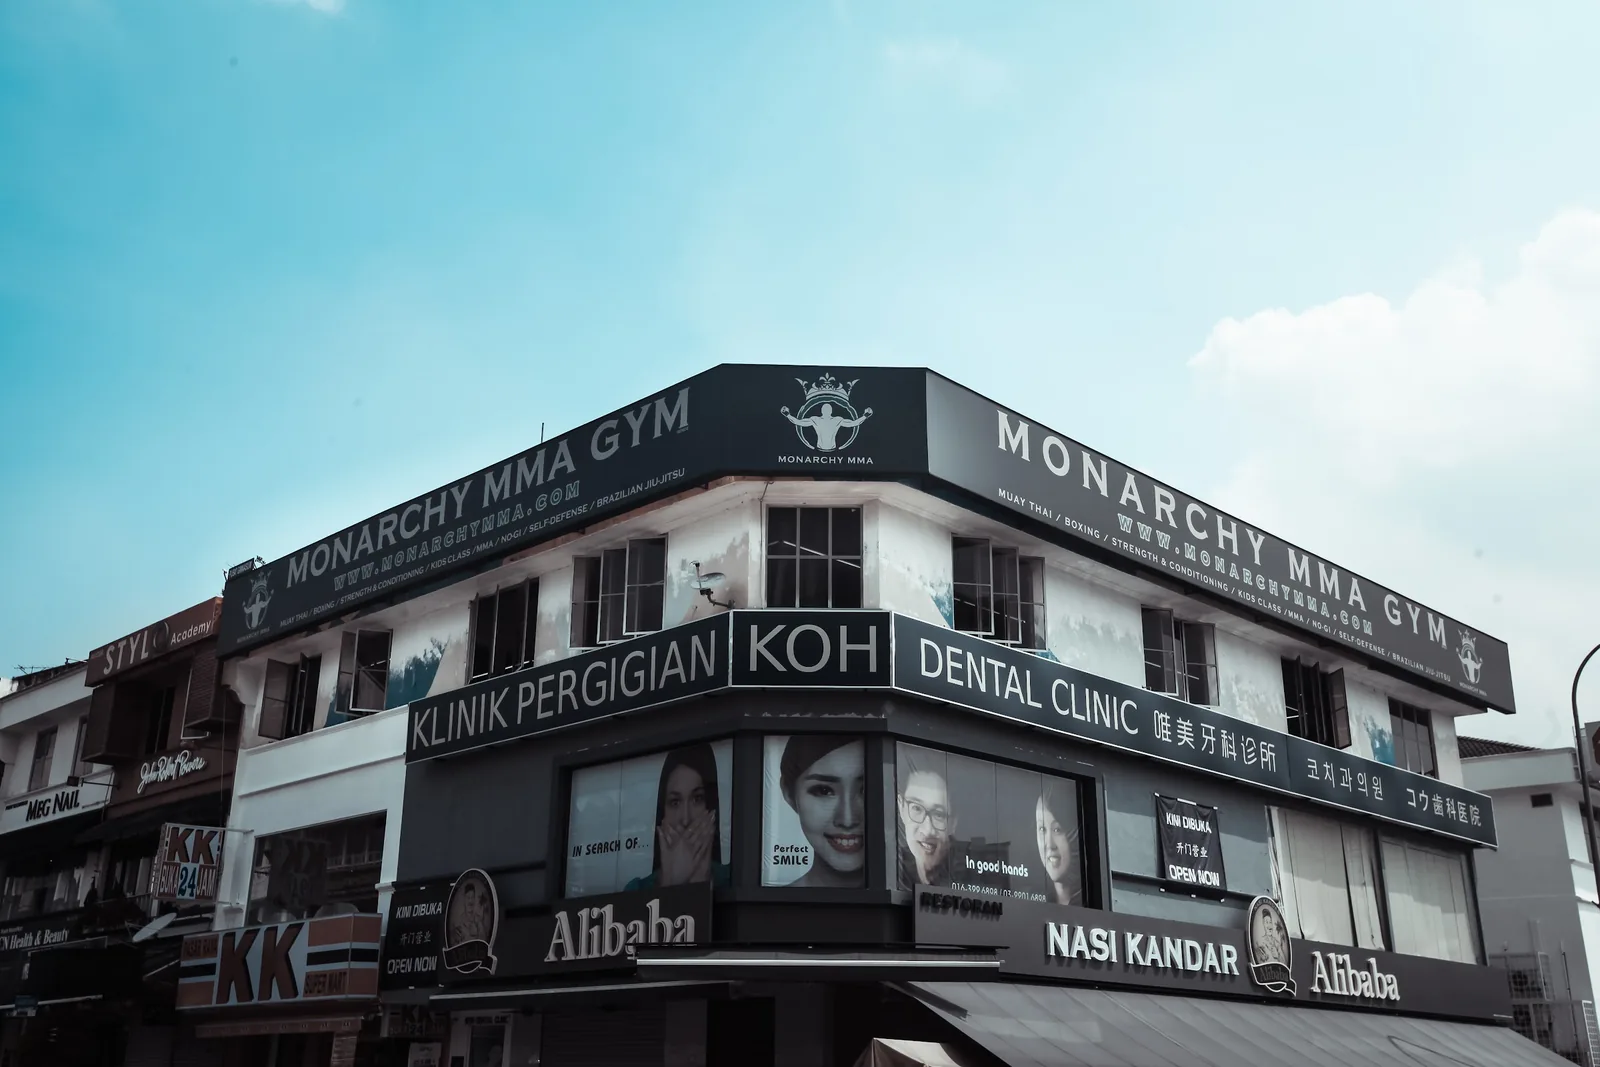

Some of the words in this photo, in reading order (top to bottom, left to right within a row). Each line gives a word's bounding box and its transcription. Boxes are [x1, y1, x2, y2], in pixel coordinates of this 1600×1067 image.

[778, 455, 843, 464] MONARCHY
[847, 456, 874, 465] MMA
[286, 480, 473, 589] MONARCHY
[483, 439, 577, 508] MMA
[590, 387, 690, 460] GYM
[280, 616, 296, 627] MUAY
[313, 600, 335, 615] BOXING
[340, 586, 372, 605] STRENGTH
[377, 566, 424, 591] CONDITIONING
[430, 557, 447, 570] KIDS
[447, 548, 471, 563] CLASS
[529, 504, 588, 532] SELF-DEFENSE
[596, 483, 643, 508] BRAZILIAN
[644, 467, 685, 490] JIU-JITSU
[333, 480, 580, 591] WWW.MONARCHYMMA.COM
[997, 410, 1266, 565] MONARCHY
[1288, 547, 1367, 612] MMA
[1384, 594, 1447, 649] GYM
[998, 488, 1027, 507] MUAY
[1029, 501, 1052, 519] THAI
[1064, 516, 1100, 539] BOXING
[1112, 537, 1159, 563] STRENGTH
[1169, 560, 1228, 591] CONDITIONING
[1238, 588, 1256, 604] KIDS
[1258, 597, 1281, 614] CLASS
[1339, 630, 1385, 656] SELF-DEFENSE
[1392, 652, 1424, 672] BRAZILIAN
[1117, 512, 1373, 636] WWW.MONARCHYMMA.COM
[170, 620, 212, 645] Academy
[748, 623, 877, 674] KOH
[412, 686, 509, 751] KLINIK
[516, 629, 716, 725] PERGIGIAN
[920, 637, 1043, 709] DENTAL
[1051, 678, 1139, 736] CLINIC
[1153, 709, 1276, 773] 唯美牙科诊所
[1307, 757, 1384, 801] 코치과의원
[26, 799, 50, 821] MEG
[52, 790, 80, 814] NAIL
[1165, 812, 1182, 828] KINI
[1182, 815, 1212, 834] DIBUKA
[1406, 787, 1482, 827] コウ歯科医院
[167, 827, 218, 864] KK
[573, 846, 582, 857] IN
[585, 840, 620, 855] SEARCH
[773, 855, 808, 866] SMILE
[774, 844, 808, 854] Perfect
[1176, 842, 1208, 858] 开门营业
[178, 867, 196, 896] 24
[197, 867, 216, 896] JAM
[965, 855, 975, 869] In
[977, 859, 999, 874] good
[1001, 861, 1029, 878] hands
[1168, 864, 1197, 883] OPEN
[1197, 869, 1220, 887] NOW
[396, 906, 411, 919] KINI
[412, 901, 443, 917] DIBUKA
[920, 891, 1003, 916] RESTORAN
[9, 932, 33, 949] Health
[34, 930, 41, 946] &
[43, 928, 69, 945] Beauty
[543, 898, 698, 963] Alibaba
[1045, 922, 1118, 963] NASI
[1123, 932, 1240, 976] KANDAR
[216, 922, 305, 1004] KK
[387, 957, 413, 975] OPEN
[414, 955, 438, 972] NOW
[1309, 950, 1400, 1001] Alibaba
